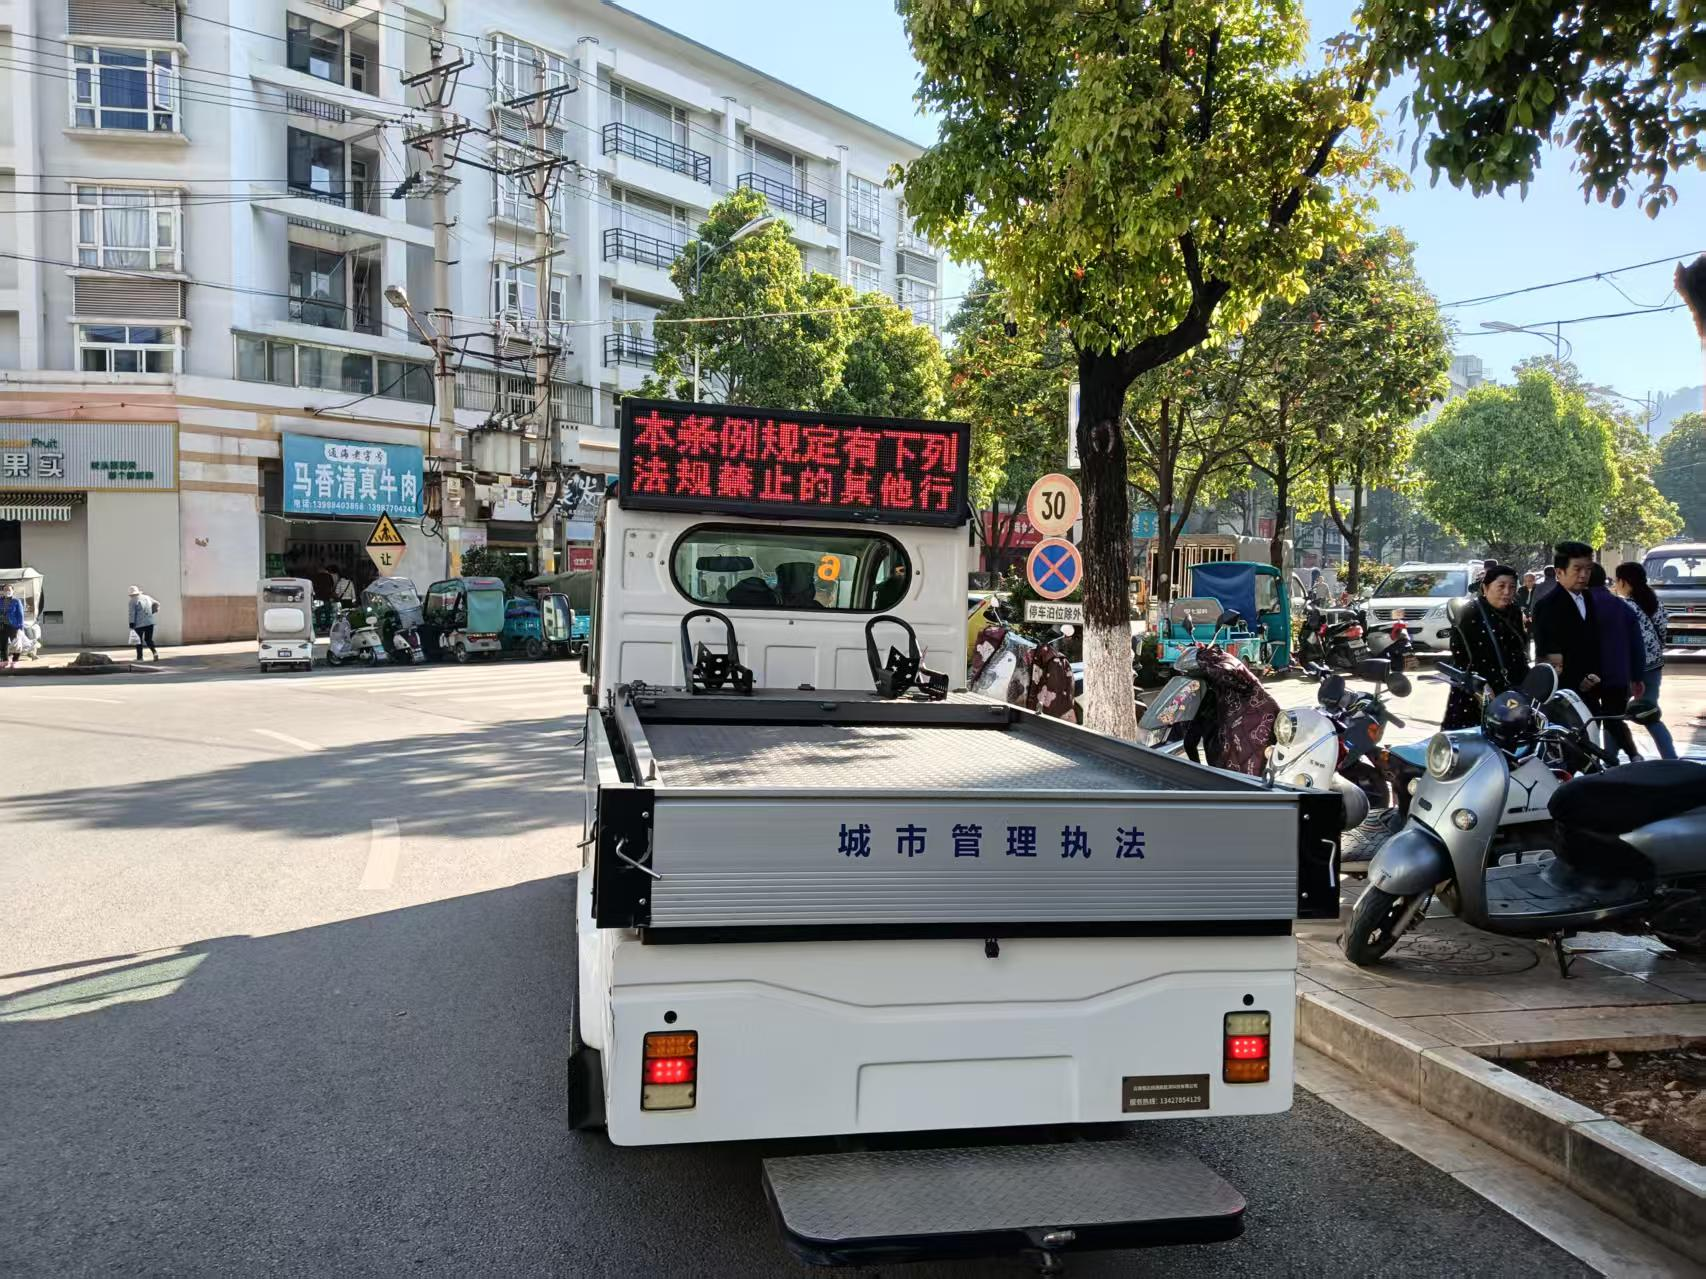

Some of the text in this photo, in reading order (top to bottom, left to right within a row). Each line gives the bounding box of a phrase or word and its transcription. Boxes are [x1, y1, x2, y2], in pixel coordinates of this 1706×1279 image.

[633, 409, 958, 473] 本条例规定有下列
[3, 452, 64, 478] 果实
[293, 462, 417, 504] 马香清真牛肉
[632, 454, 954, 511] 法规禁止的其他行
[1041, 491, 1066, 520] 30
[380, 553, 392, 566] 让
[1029, 605, 1082, 621] 停车泊位除外
[838, 823, 1146, 860] 城市管理执法
